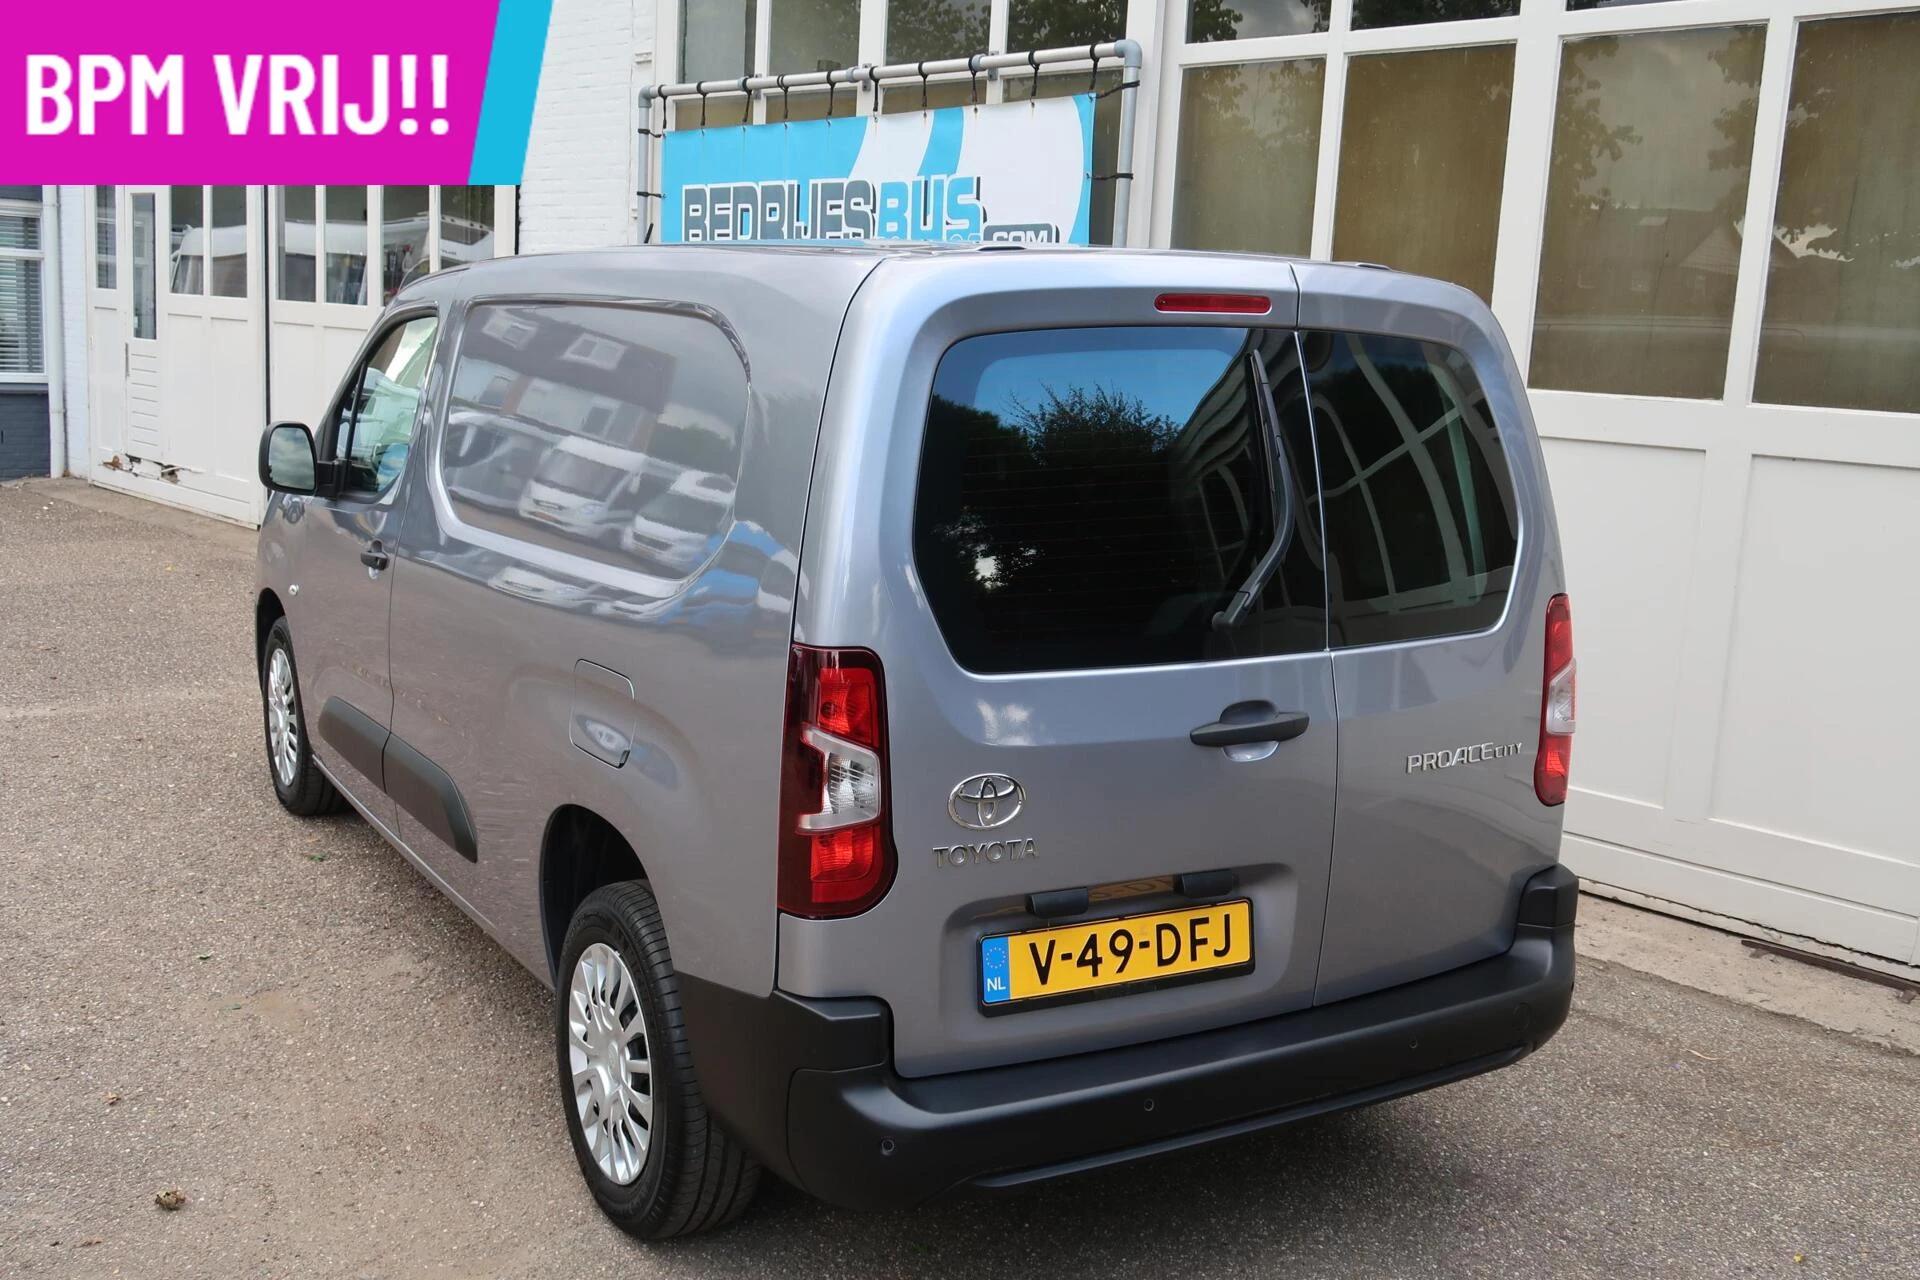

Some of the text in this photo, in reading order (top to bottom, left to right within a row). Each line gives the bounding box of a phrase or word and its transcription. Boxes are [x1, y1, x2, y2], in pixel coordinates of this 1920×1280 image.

[1406, 742, 1522, 774] PROACE CITY
[933, 838, 1039, 868] TOYOTA
[1029, 913, 1232, 986] V-49-DFJ
[987, 977, 1006, 992] NL
